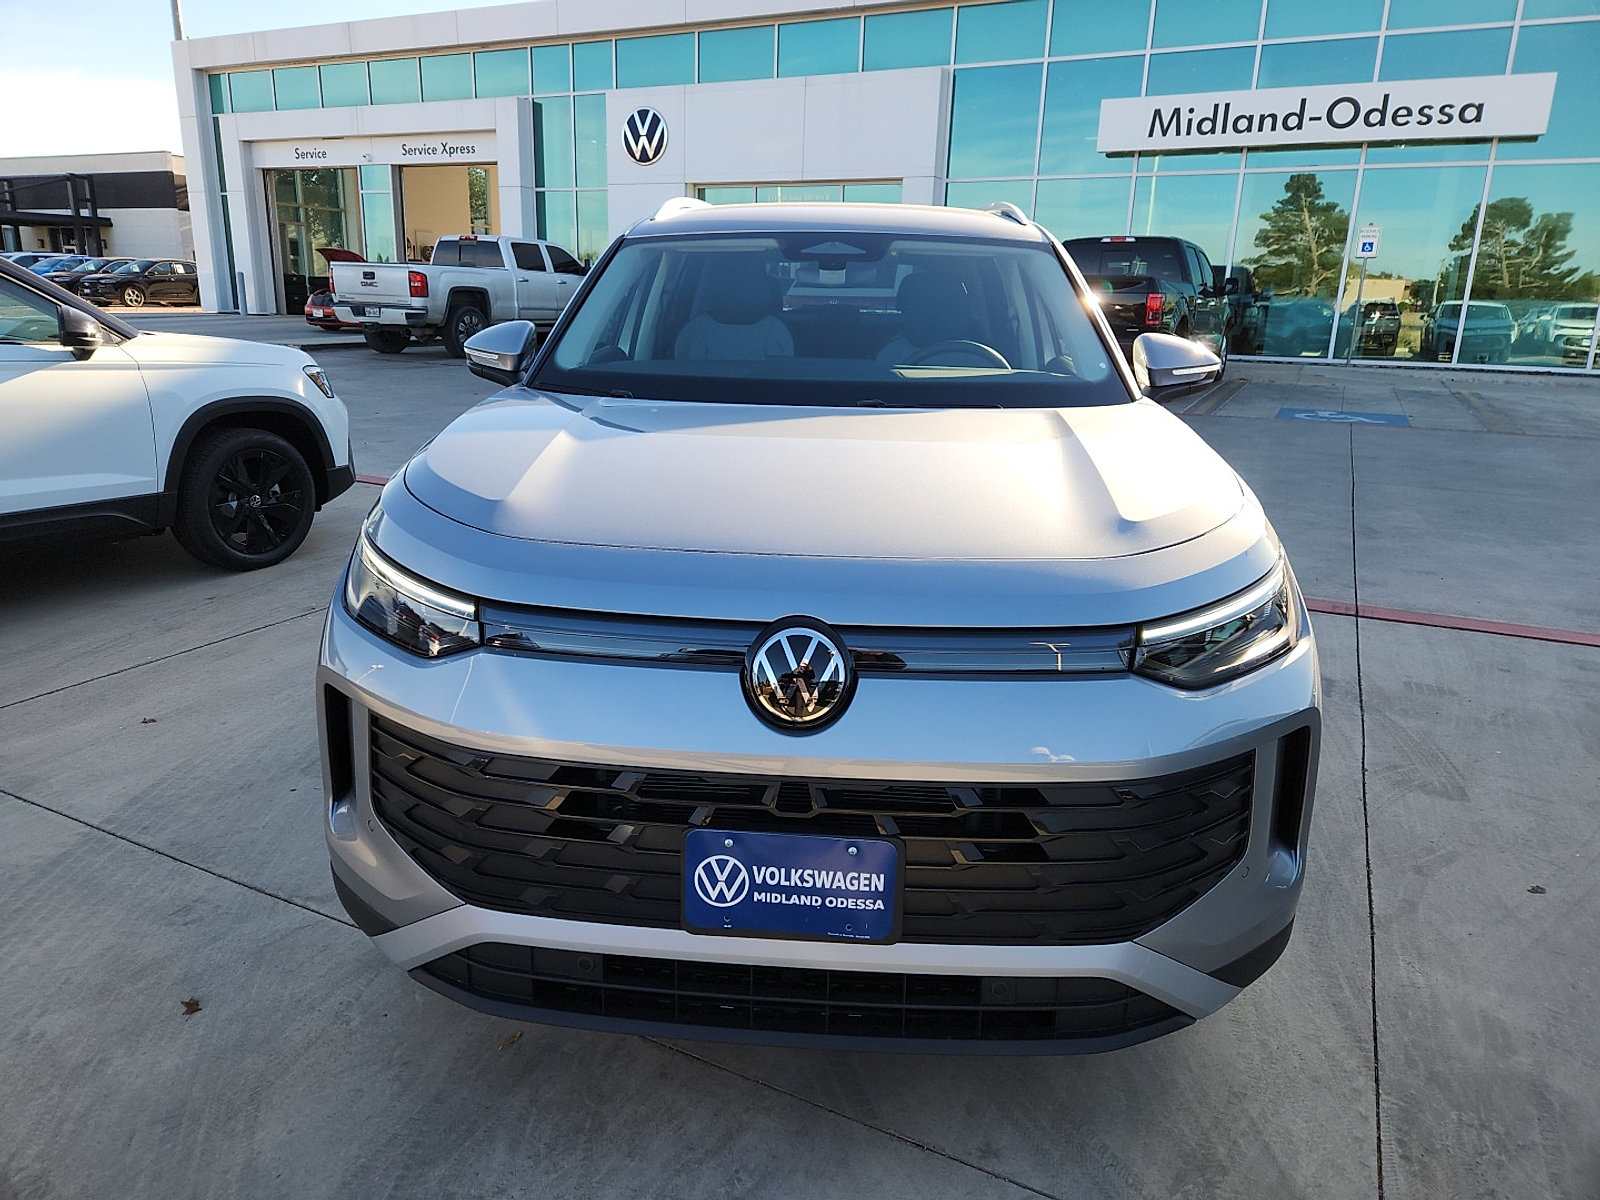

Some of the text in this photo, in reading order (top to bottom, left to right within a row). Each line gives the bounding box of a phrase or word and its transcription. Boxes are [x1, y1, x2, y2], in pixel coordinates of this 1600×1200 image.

[1147, 93, 1485, 138] Midland-Odessa
[294, 147, 327, 159] Service
[401, 142, 476, 157] Service Xpress
[752, 865, 885, 892] VOLKSWAGEN
[753, 891, 885, 911] MIDLAND ODESSA
